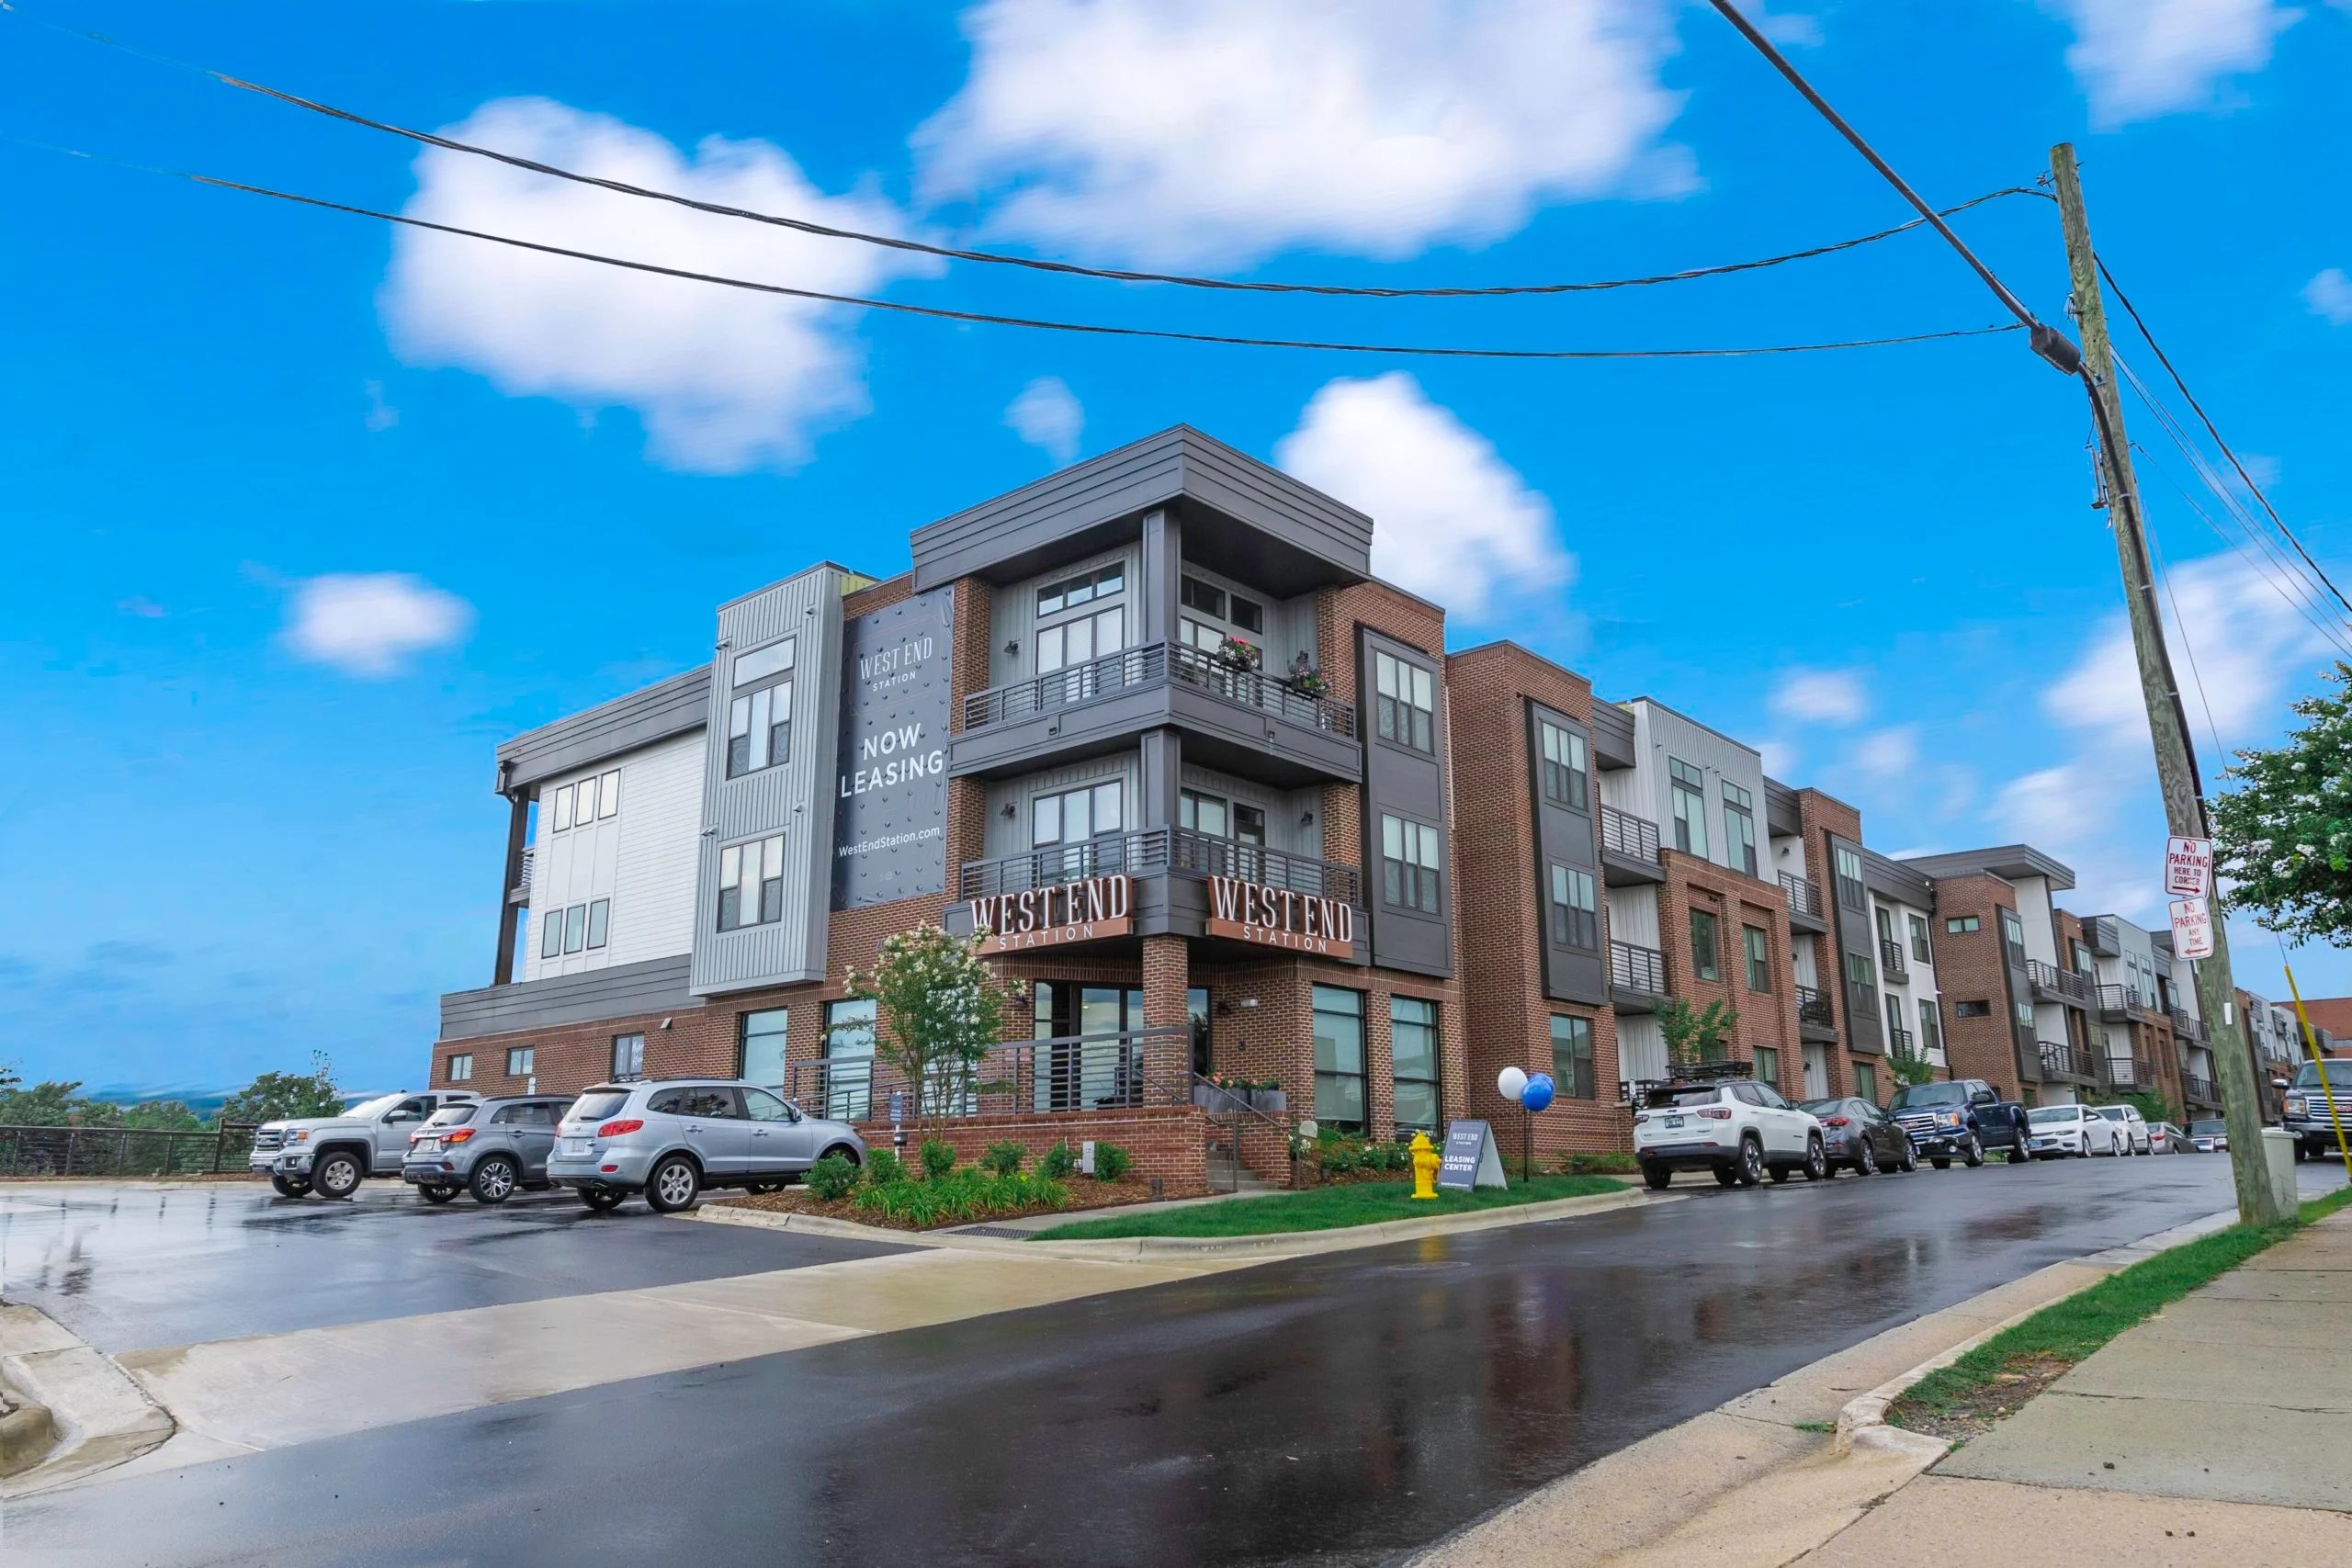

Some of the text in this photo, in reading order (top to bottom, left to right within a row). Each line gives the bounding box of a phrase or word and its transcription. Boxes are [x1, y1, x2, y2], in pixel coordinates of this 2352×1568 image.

[860, 637, 933, 680] WEST END
[873, 671, 917, 692] STATION
[864, 722, 922, 761] NOW
[841, 750, 944, 798] LEASING
[839, 827, 940, 857] WestEndStation.com
[2183, 841, 2197, 853] NO
[2169, 853, 2208, 867] PARKING
[2174, 866, 2201, 877] HERE TO
[970, 874, 1128, 936] WEST END
[1212, 875, 1353, 943] WEST END
[2183, 902, 2195, 914] NO
[2175, 914, 2207, 928] PARKING
[2188, 928, 2199, 936] ANY
[999, 924, 1093, 951] STATION
[1242, 925, 1328, 953] STATION
[2188, 937, 2203, 946] TIME
